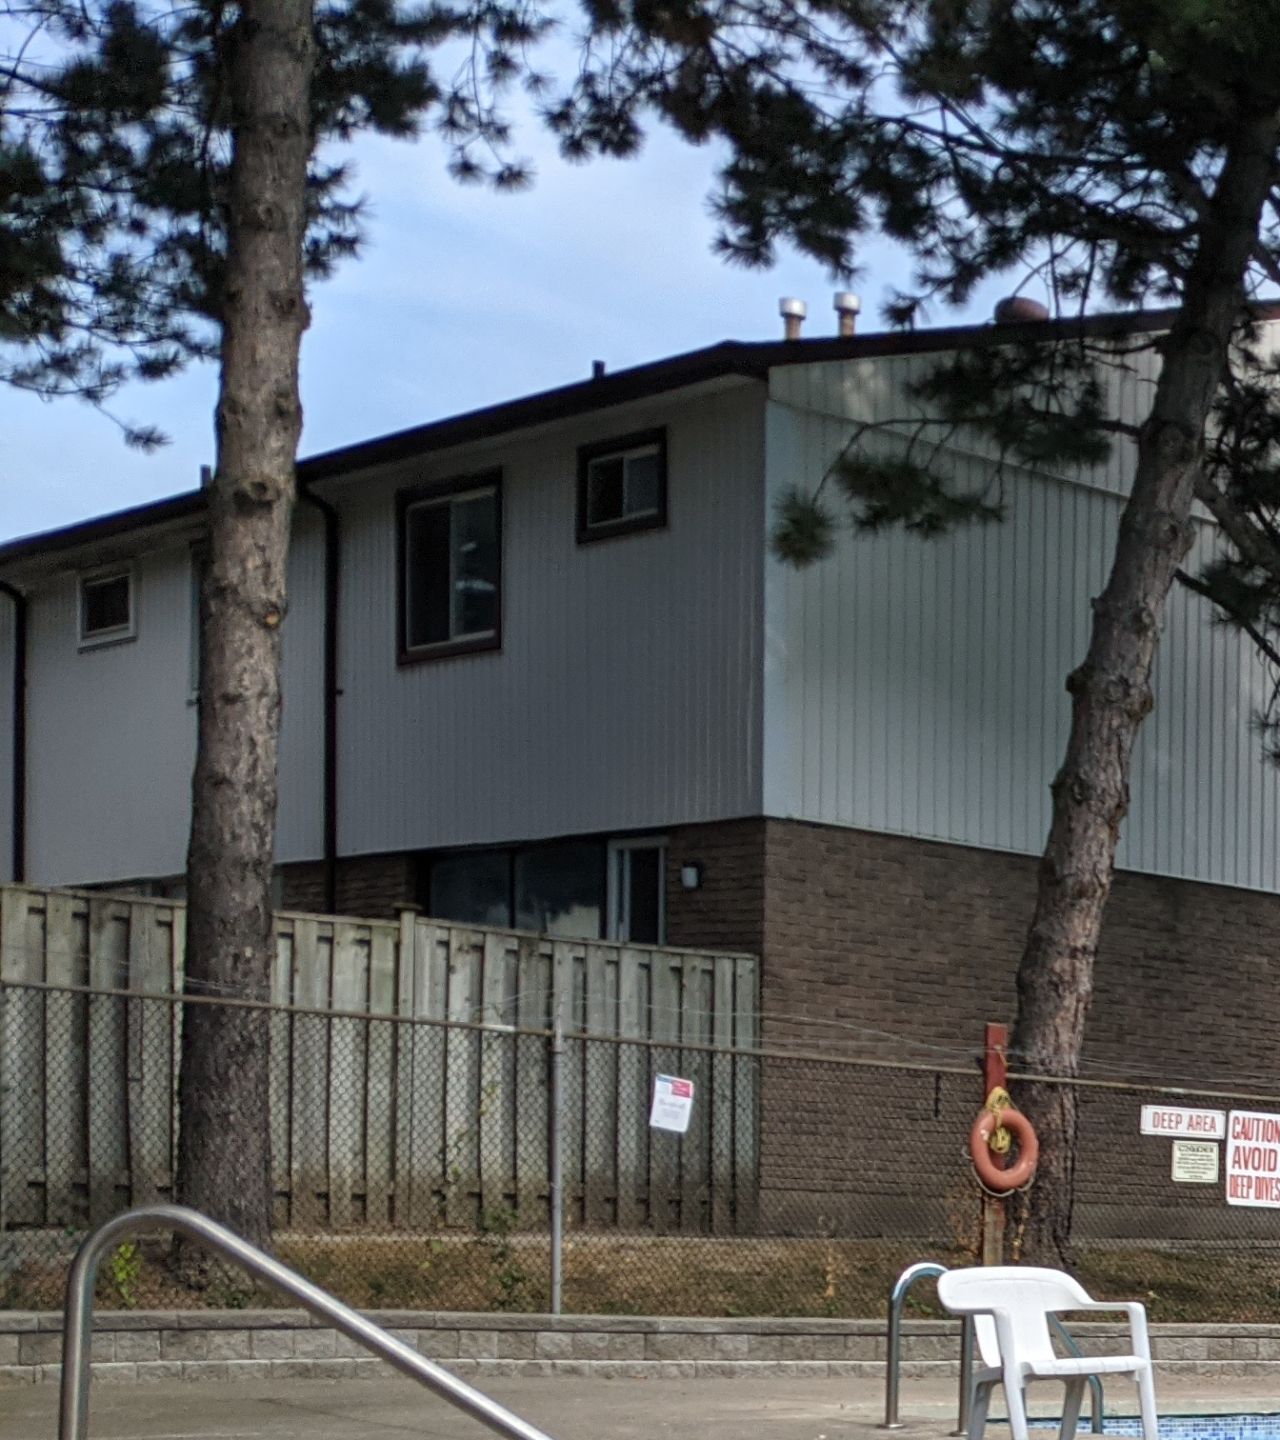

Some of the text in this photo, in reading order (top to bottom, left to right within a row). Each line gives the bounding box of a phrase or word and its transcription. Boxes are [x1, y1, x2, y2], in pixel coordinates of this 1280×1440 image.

[1152, 1111, 1217, 1133] DEEP AREA
[1232, 1145, 1278, 1172] AVOID
[1229, 1174, 1280, 1202] DEEP DIVES
